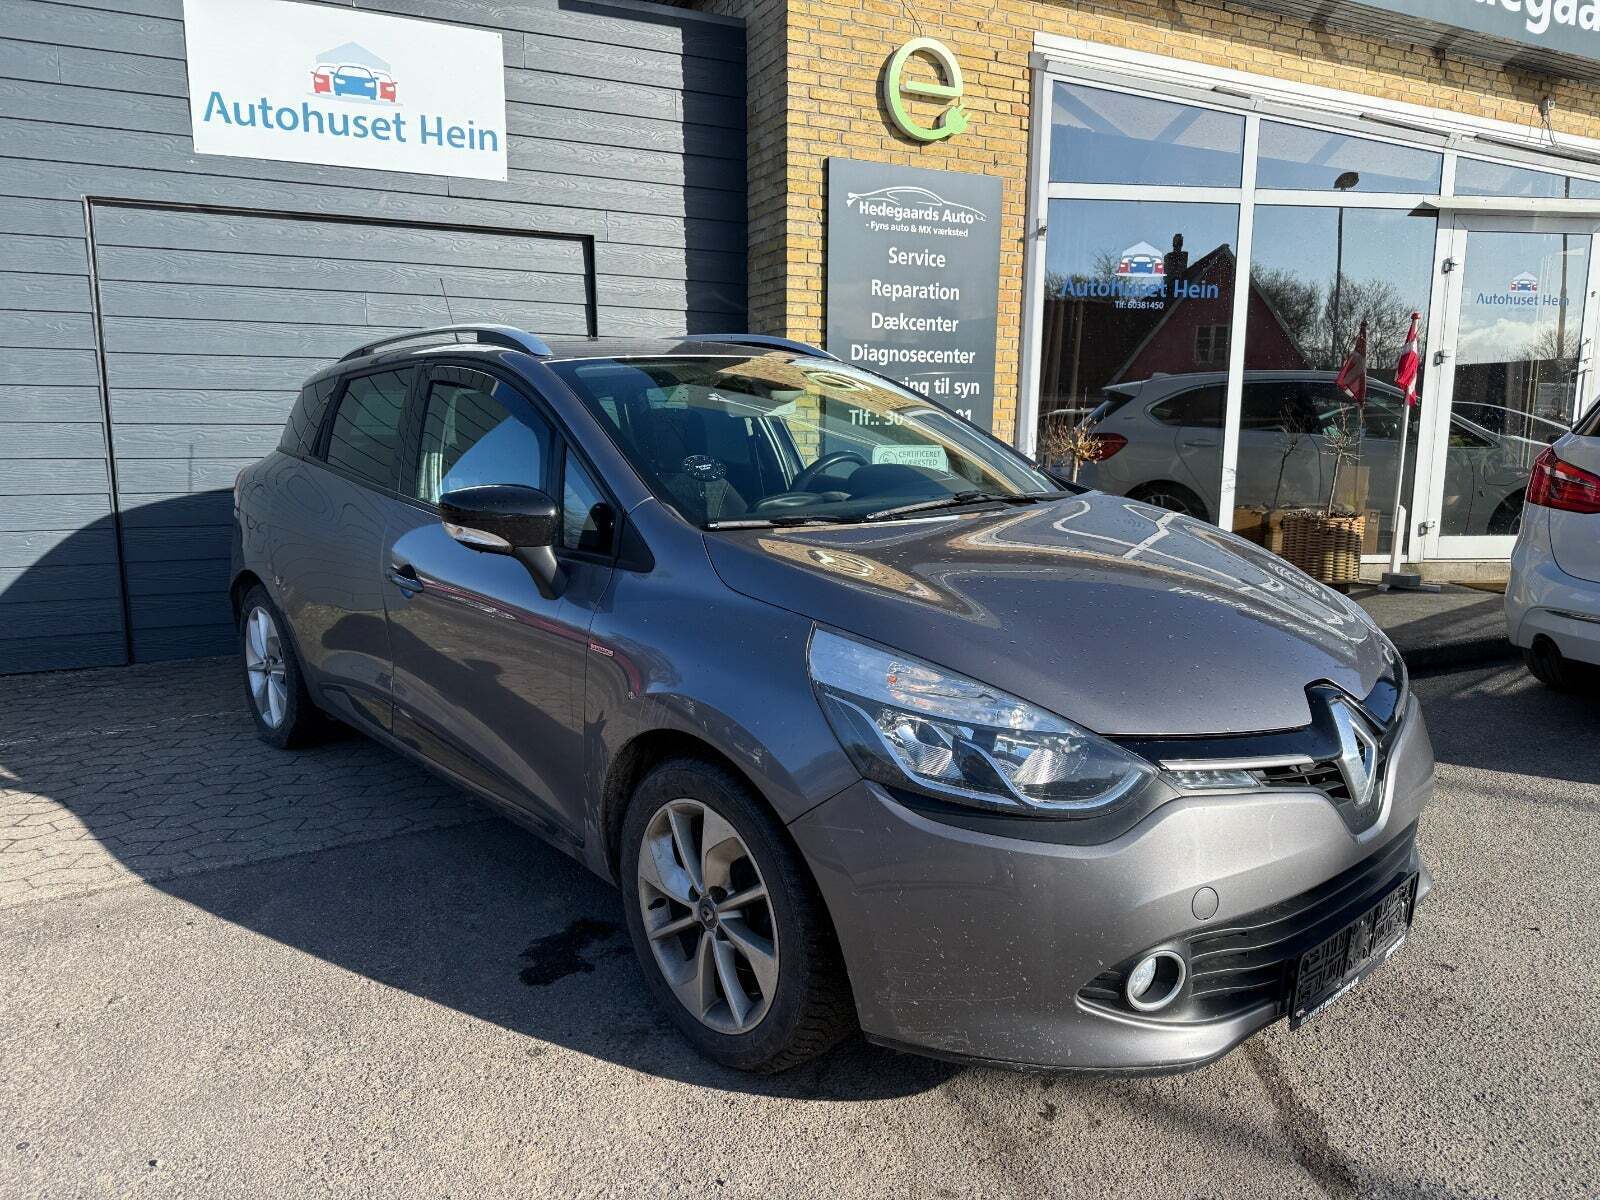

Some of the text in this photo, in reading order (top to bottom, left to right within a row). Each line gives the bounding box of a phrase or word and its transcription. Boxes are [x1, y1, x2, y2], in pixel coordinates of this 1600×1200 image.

[203, 91, 498, 152] Autohuset Hein
[859, 201, 974, 225] Hedegaards Auto
[870, 221, 889, 231] Fyns
[890, 224, 909, 232] auto
[910, 225, 917, 233] &
[918, 225, 932, 235] MX
[888, 247, 946, 268] Service
[871, 279, 960, 302] Reparation
[1061, 277, 1219, 299] Autohuset Hein
[1476, 293, 1539, 306] Autohuset
[871, 312, 959, 333] Dækcenter
[851, 343, 976, 366] Diagnosecenter
[934, 377, 950, 395] til
[954, 382, 980, 399] syn
[849, 409, 880, 426] Tlf.:
